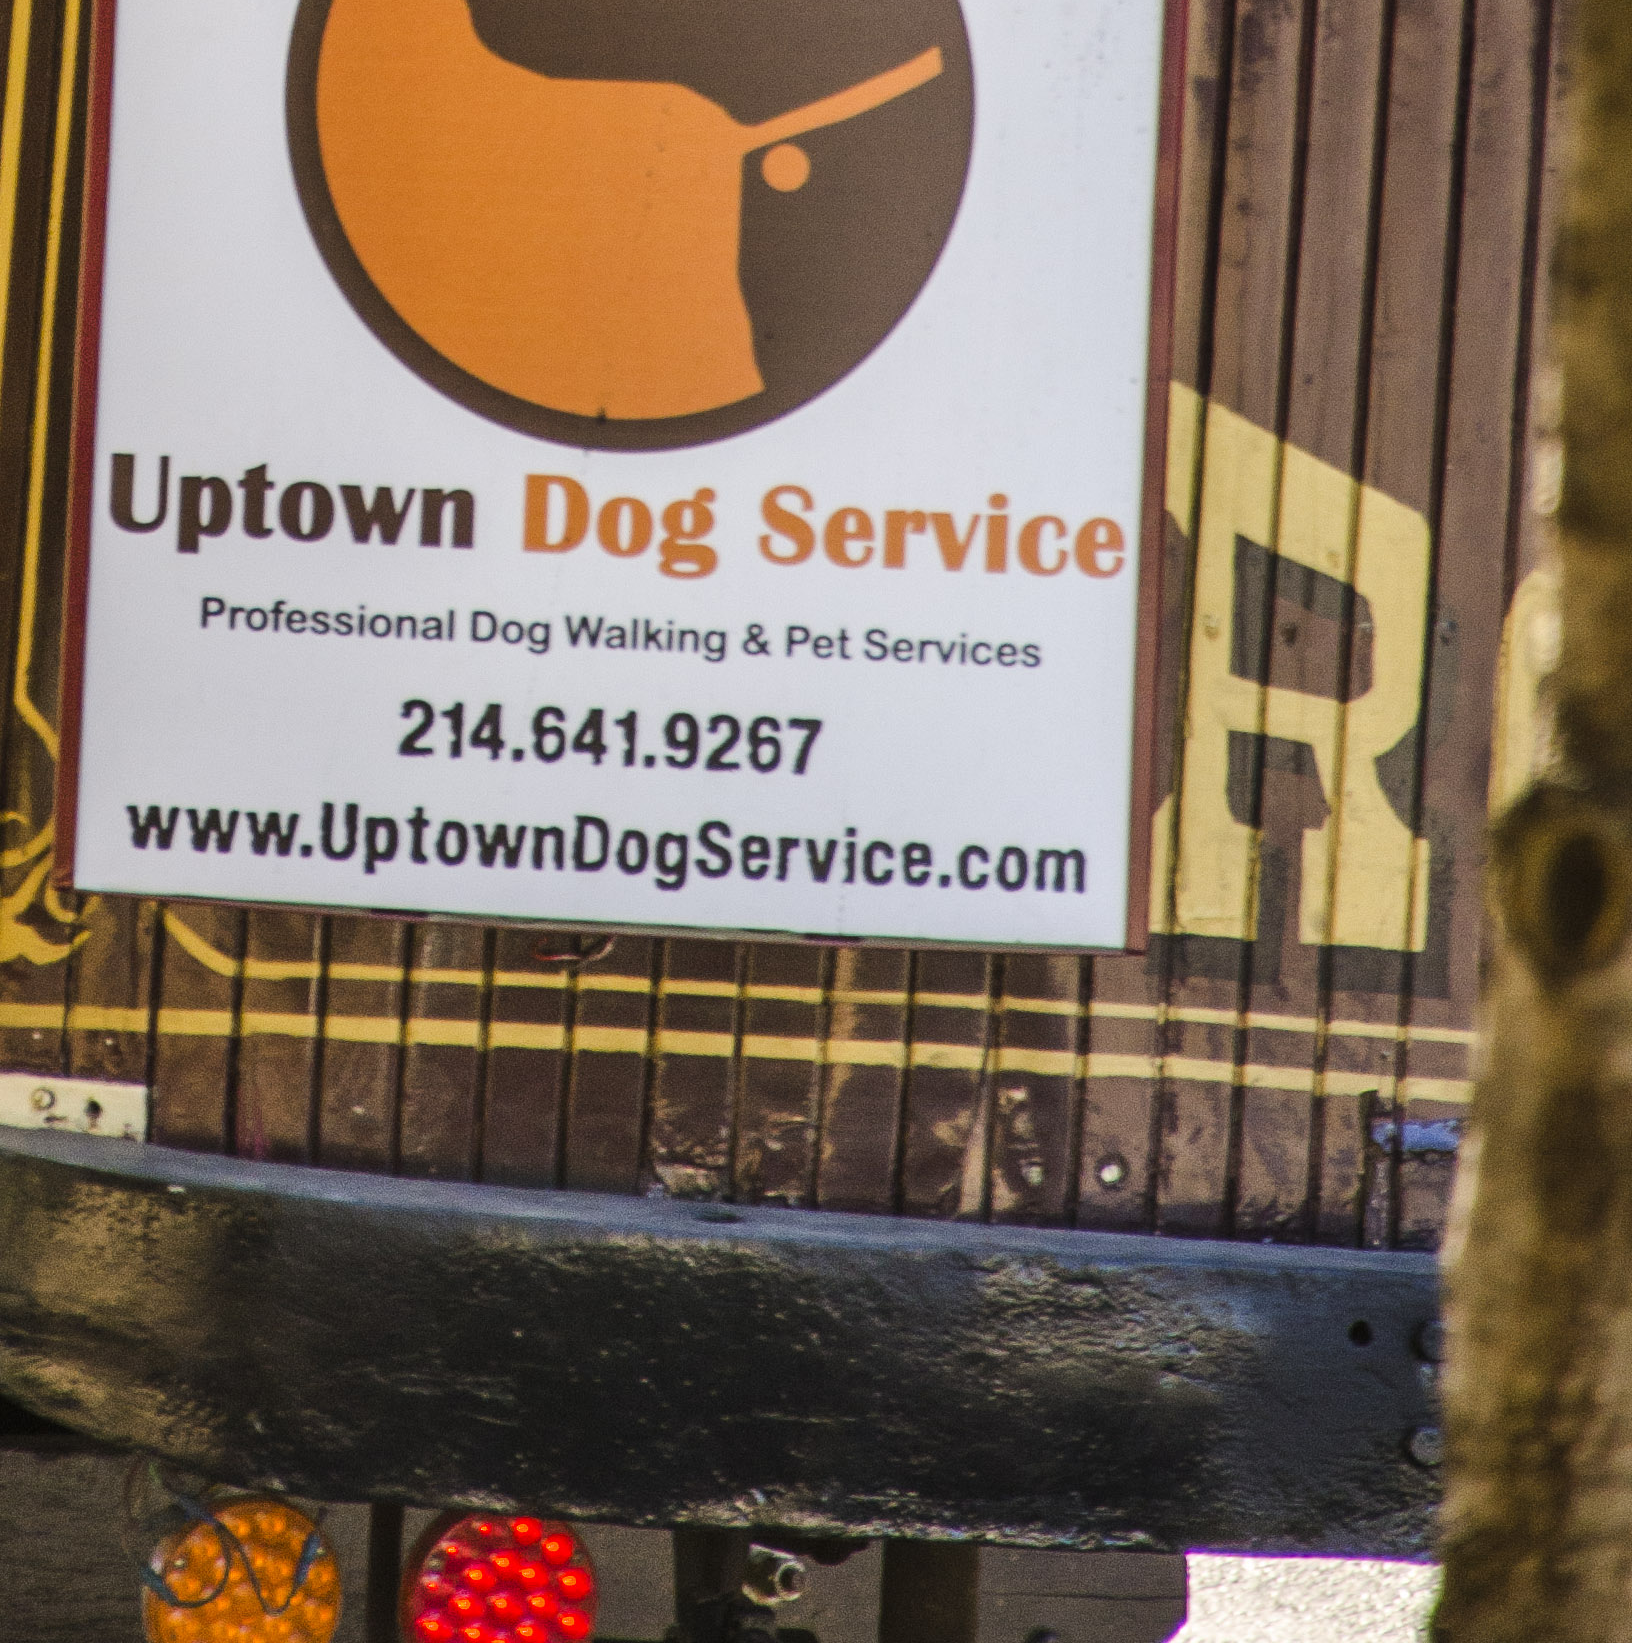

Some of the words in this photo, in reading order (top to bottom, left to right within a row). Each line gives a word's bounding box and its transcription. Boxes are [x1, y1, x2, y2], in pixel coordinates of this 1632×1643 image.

[110, 453, 474, 554] Uptown
[524, 474, 716, 577] Dog
[761, 486, 1122, 575] Service
[202, 596, 454, 639] Professional
[472, 611, 550, 654] Dog
[566, 617, 726, 661] Walking
[743, 624, 768, 654] &
[787, 626, 848, 658] Pet
[866, 629, 1039, 666] Services
[399, 699, 822, 774] 214.641.9267
[125, 801, 1087, 891] www.UptownDogService.com
